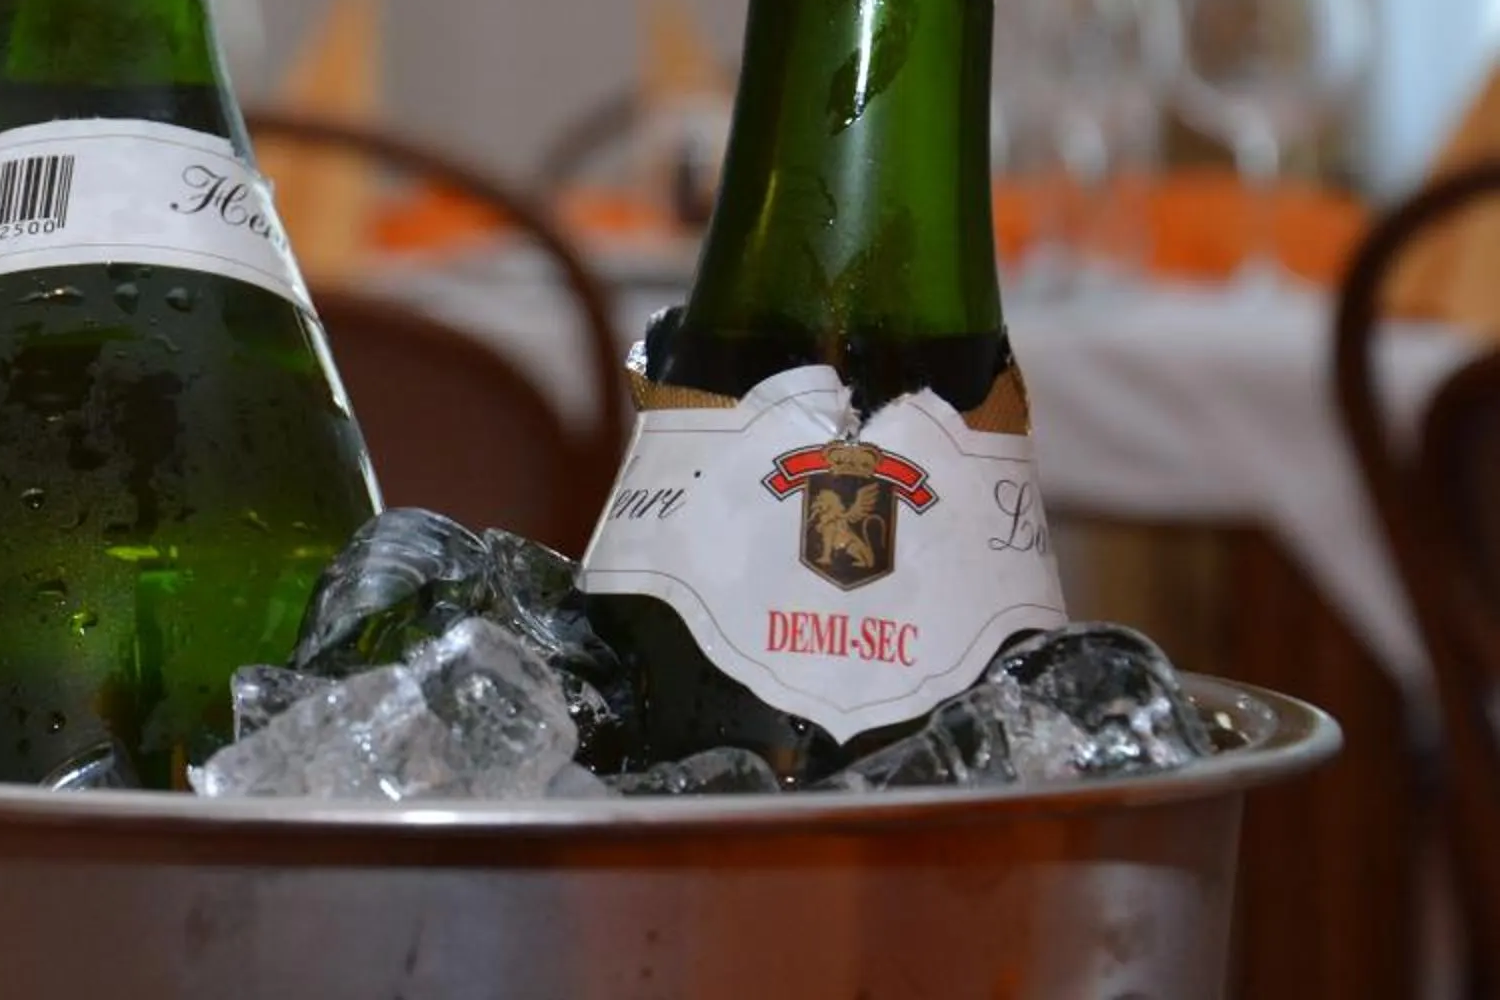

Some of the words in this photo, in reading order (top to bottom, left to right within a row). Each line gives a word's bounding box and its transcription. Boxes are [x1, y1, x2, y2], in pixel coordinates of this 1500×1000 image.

[169, 164, 286, 248] He
[608, 456, 701, 520] enri
[766, 610, 918, 667] DEMI-SEC
